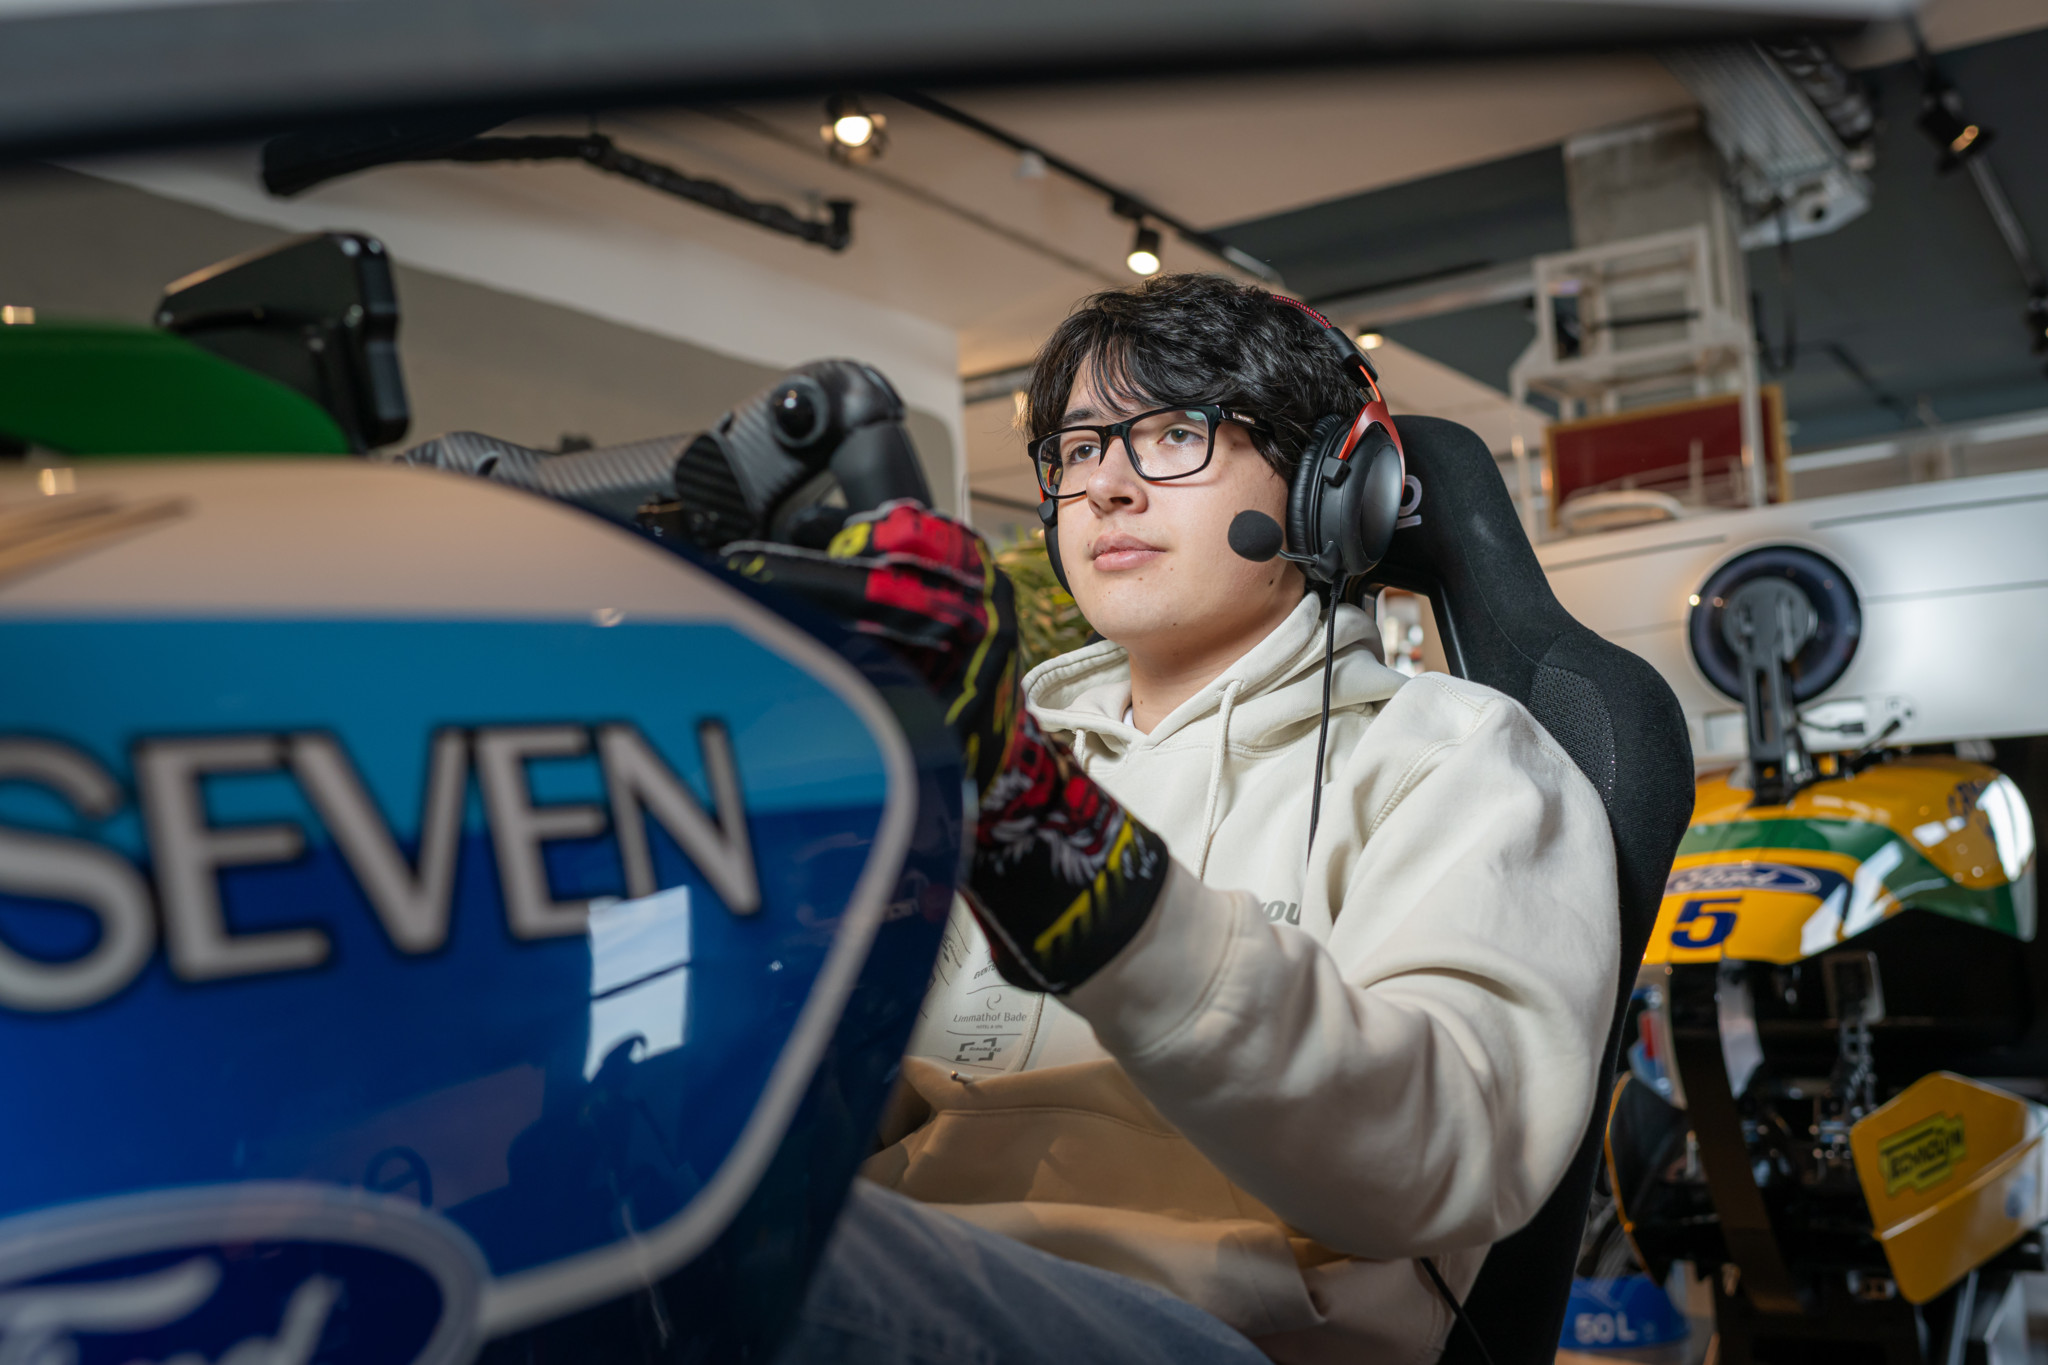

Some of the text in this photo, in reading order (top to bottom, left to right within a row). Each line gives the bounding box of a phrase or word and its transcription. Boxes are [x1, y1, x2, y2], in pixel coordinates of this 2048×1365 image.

[0, 716, 762, 1012] SEVEN
[1670, 898, 1743, 949] 5
[953, 1011, 1001, 1023] Limmathof
